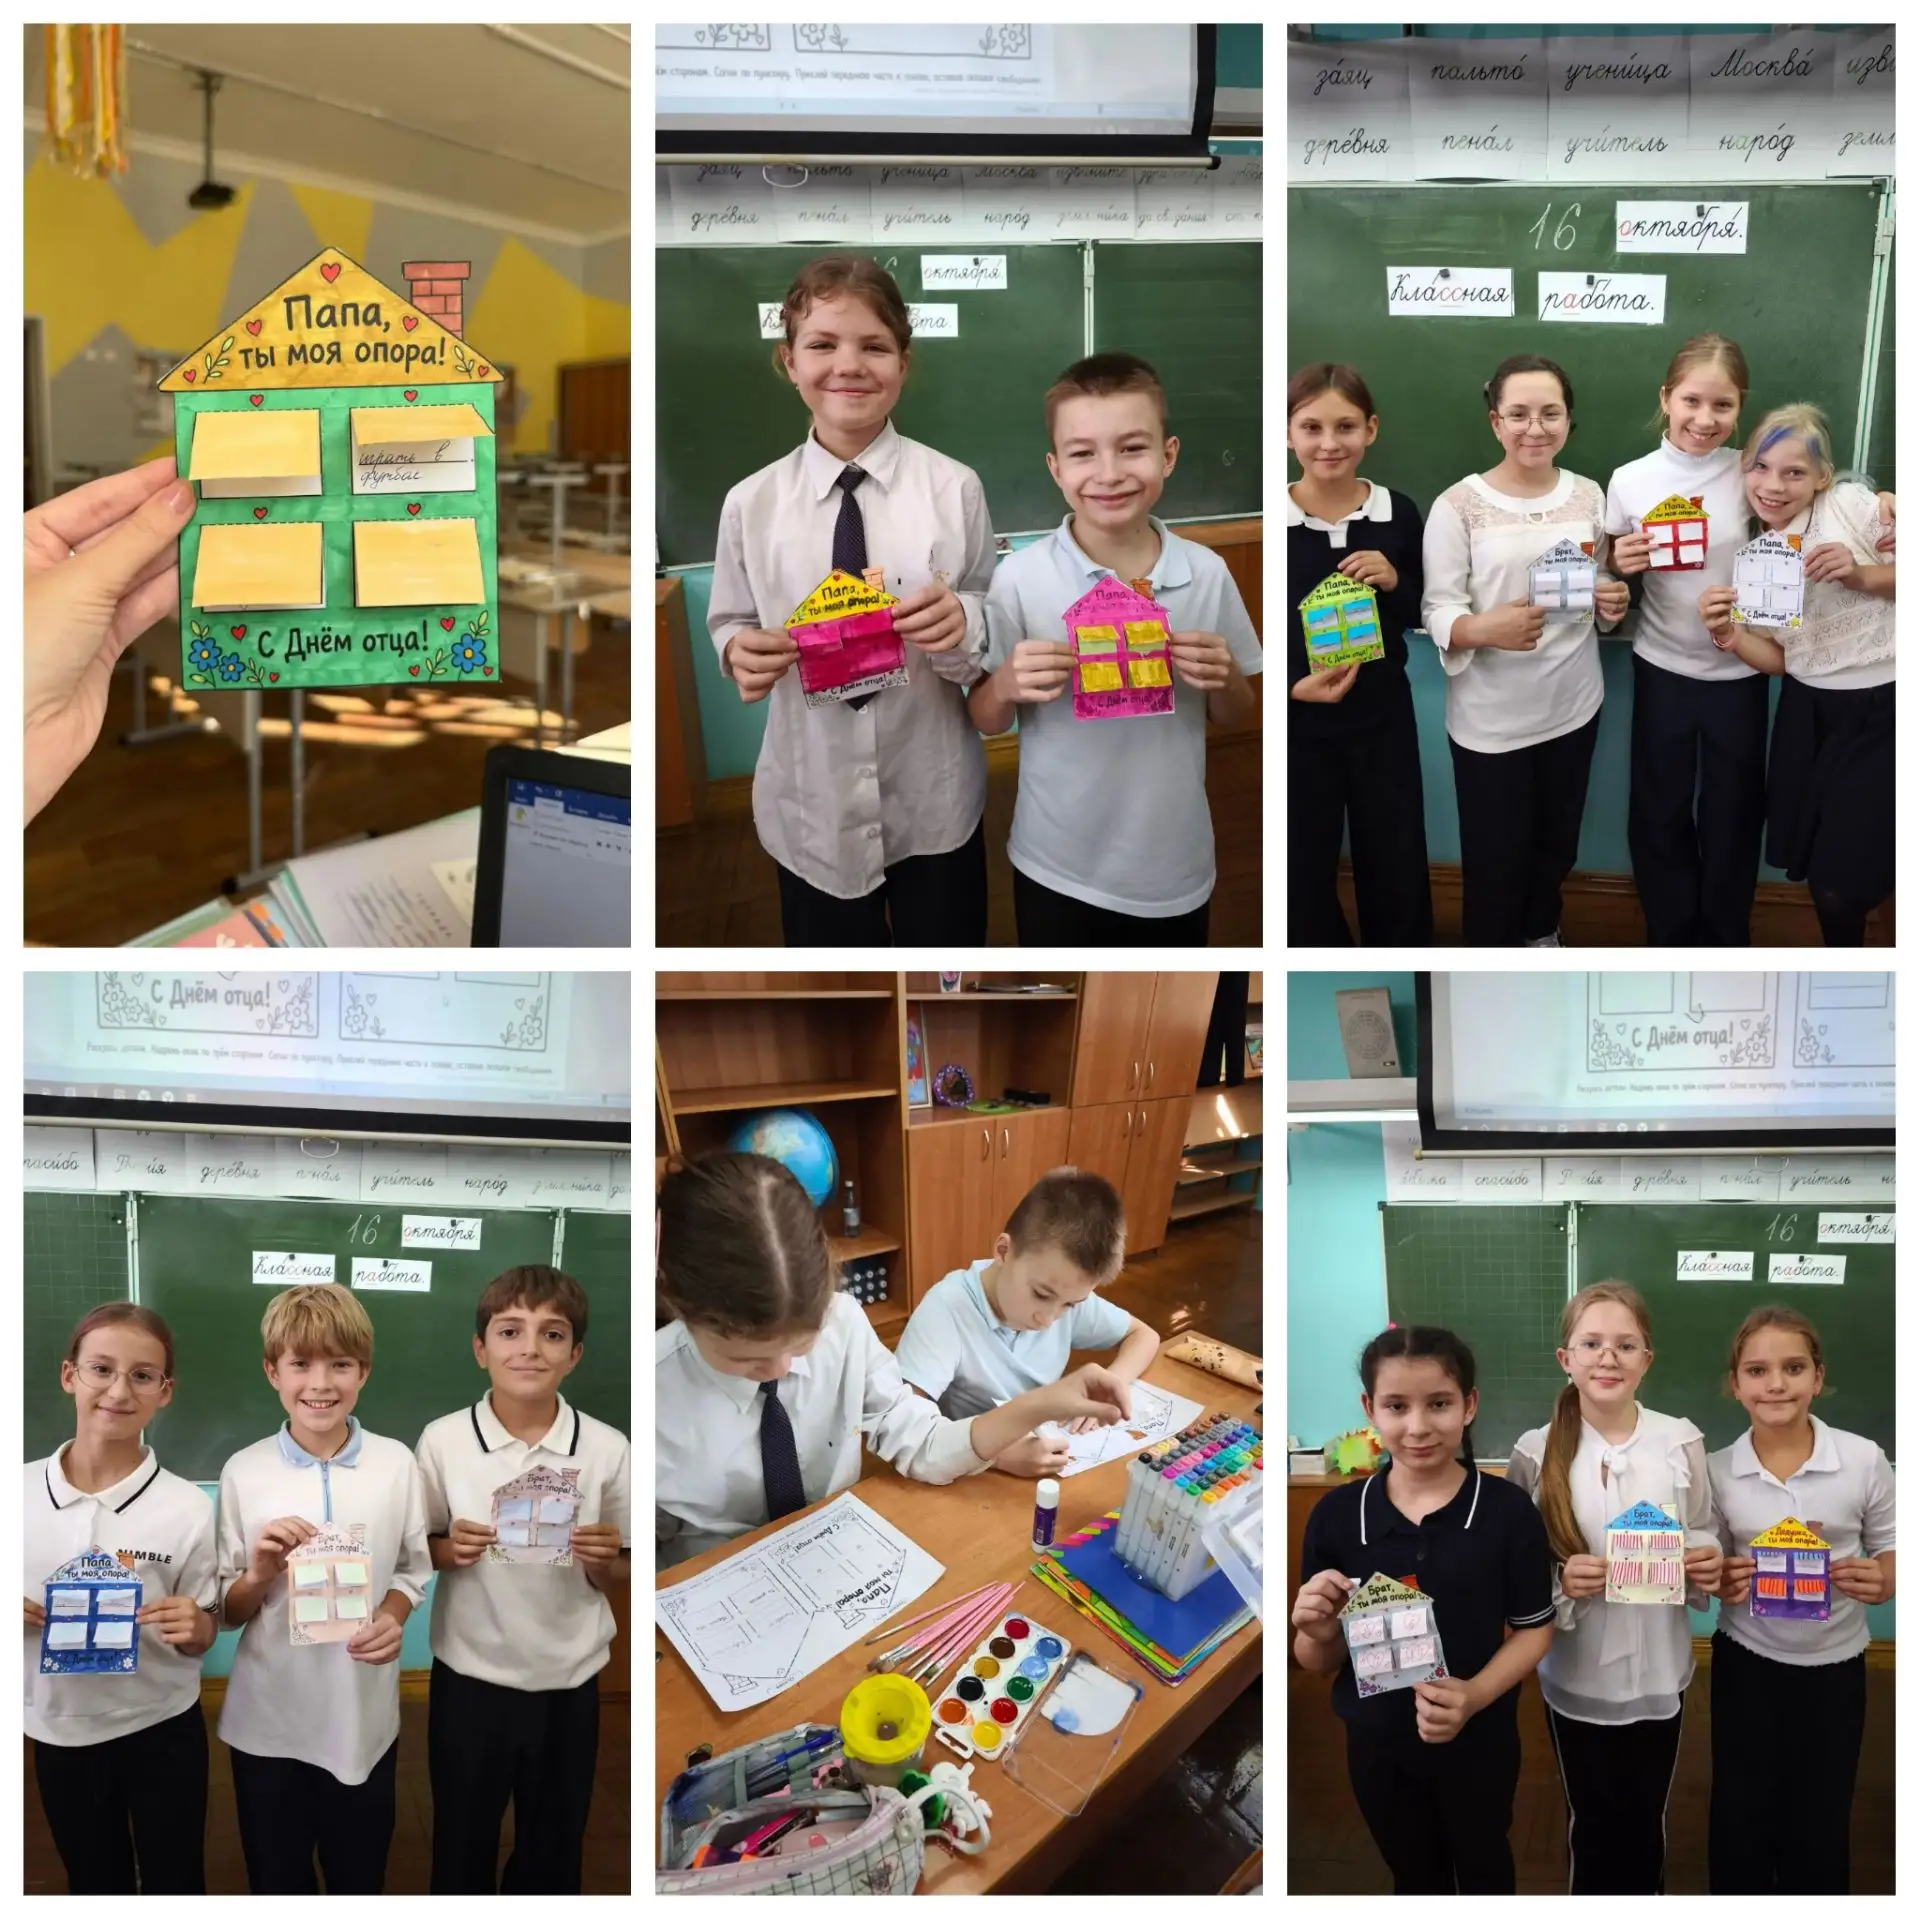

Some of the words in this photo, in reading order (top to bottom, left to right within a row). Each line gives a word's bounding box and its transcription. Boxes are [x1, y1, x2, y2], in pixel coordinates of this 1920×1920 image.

[1710, 47, 1816, 79] Москва́
[1718, 122, 1796, 163] наро́д
[798, 204, 849, 225] пна́л
[1528, 202, 1582, 251] 16
[283, 294, 391, 334] Папа,
[239, 347, 276, 370] ты
[287, 341, 342, 367] моя
[354, 336, 448, 373] опора!
[1759, 538, 1784, 549] Папа,
[821, 585, 860, 601] Папа,
[1323, 578, 1351, 590] Папа,
[1095, 589, 1131, 602] Папа,
[808, 606, 822, 617] ты
[824, 601, 845, 613] моя
[1752, 610, 1770, 619] Днём
[257, 627, 276, 658] С
[284, 625, 353, 662] Днём
[361, 619, 430, 655] отца!
[150, 978, 164, 1004] С
[168, 978, 219, 1010] Днём
[224, 980, 272, 1012] отца!
[1631, 1027, 1643, 1049] С
[1646, 1025, 1689, 1052] Днём
[1692, 1021, 1735, 1049] отца!
[347, 1213, 381, 1245] 16
[1765, 1212, 1799, 1242] 16
[545, 1485, 572, 1495] пора!
[1633, 1508, 1656, 1519] Брат,
[81, 1569, 99, 1578] моя
[101, 1569, 130, 1581] опора!
[857, 1583, 892, 1605] Папа,
[1356, 1599, 1370, 1610] ты
[1371, 1596, 1389, 1606] моя
[1389, 1591, 1418, 1603] опора!
[1367, 1583, 1396, 1597] Брат,
